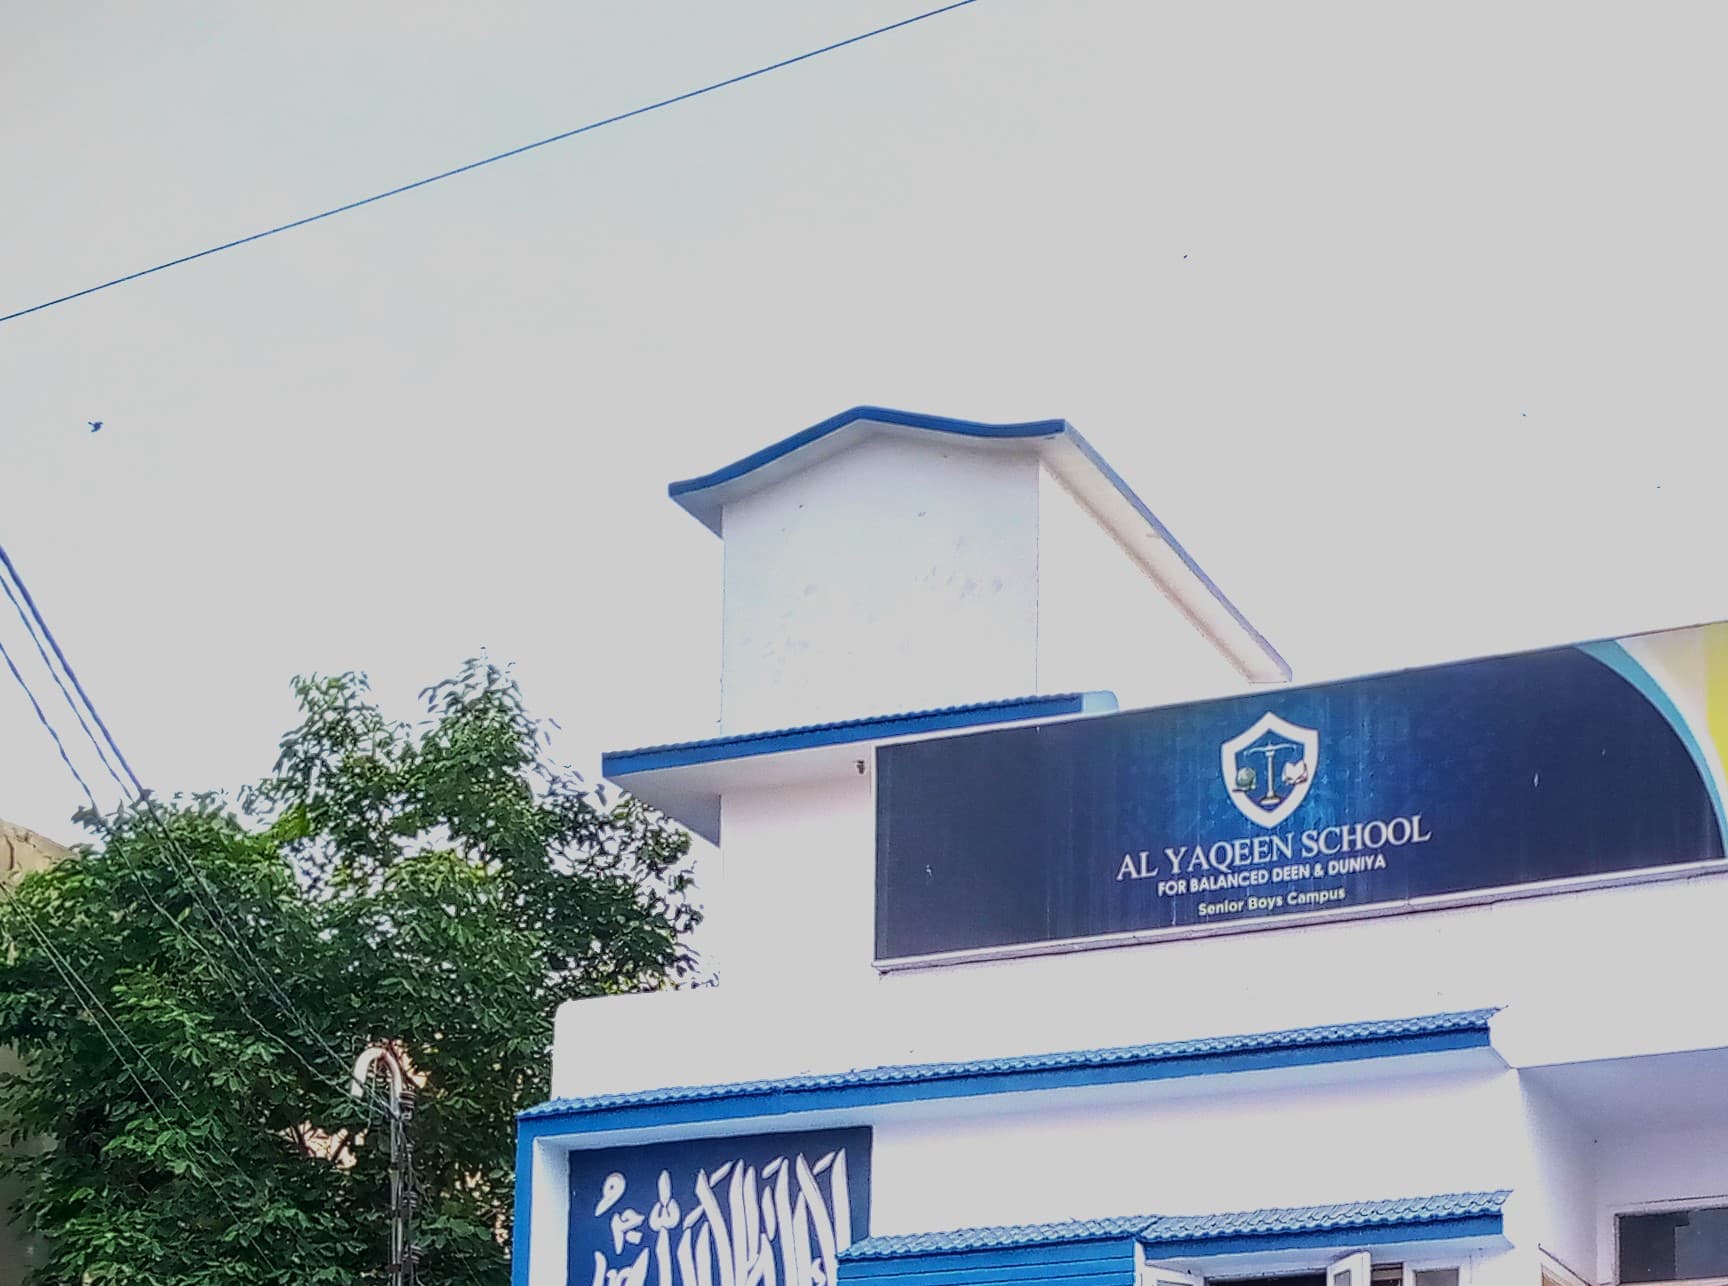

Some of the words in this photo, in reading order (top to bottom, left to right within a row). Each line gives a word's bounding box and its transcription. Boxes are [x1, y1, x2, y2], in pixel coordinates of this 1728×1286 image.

[1116, 851, 1159, 881] AL
[1164, 831, 1296, 873] YAQEEN
[1301, 815, 1432, 857] SCHOOL
[1158, 880, 1187, 896] FOR
[1190, 869, 1269, 892] BALANCED
[1272, 864, 1310, 883] DEEN
[1314, 863, 1325, 878] &
[1328, 853, 1387, 875] DUNIYA
[1198, 900, 1245, 916] Senior
[1248, 893, 1284, 911] Boys
[1287, 886, 1346, 906] Campus
